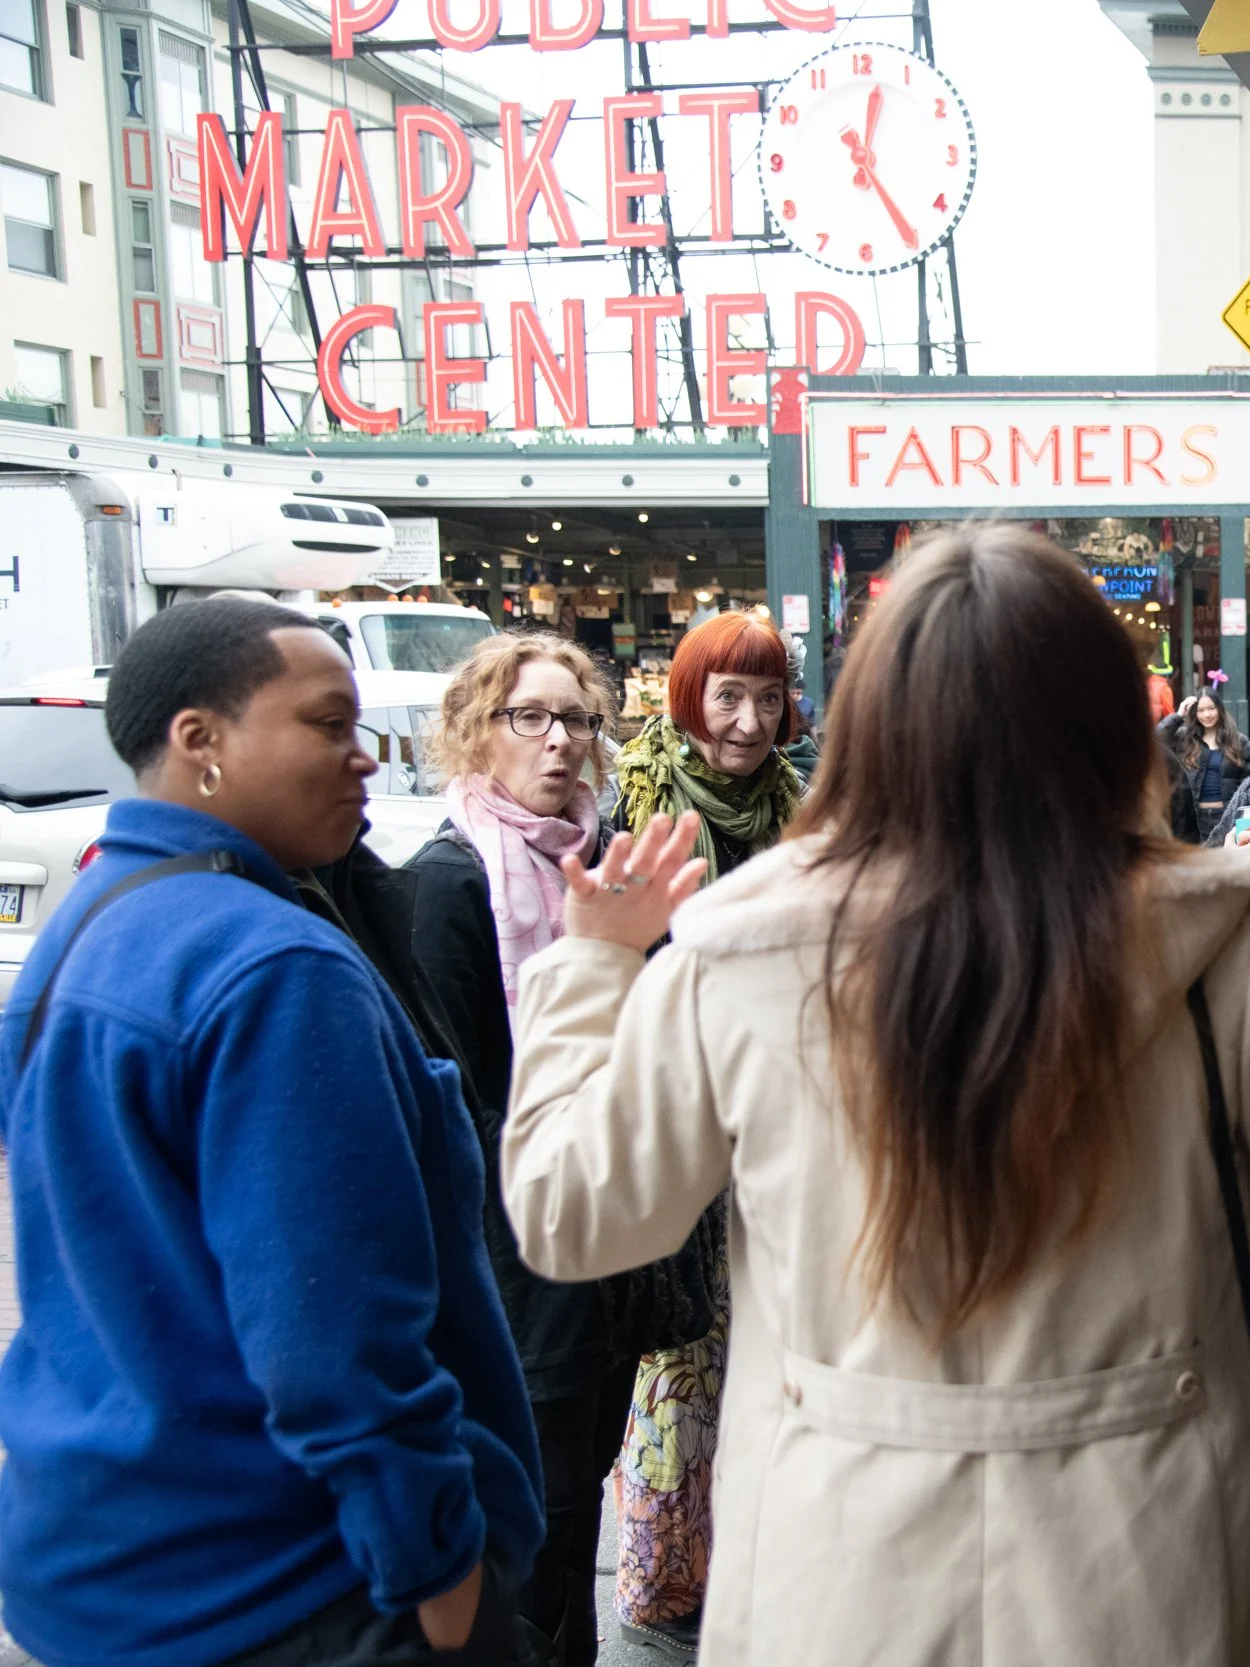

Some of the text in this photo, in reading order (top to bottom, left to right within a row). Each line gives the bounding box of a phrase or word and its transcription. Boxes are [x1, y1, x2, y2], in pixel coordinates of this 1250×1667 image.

[853, 54, 872, 75] 12
[811, 69, 826, 90] 11
[904, 65, 910, 85] 1
[780, 105, 799, 125] 10
[935, 98, 947, 119] 2
[770, 153, 784, 173] 9
[947, 145, 959, 165] 3
[197, 91, 761, 262] MARKET
[782, 200, 796, 220] 8
[933, 193, 948, 213] 4
[816, 233, 830, 252] 7
[859, 243, 873, 262] 6
[847, 424, 1218, 488] FARMERS
